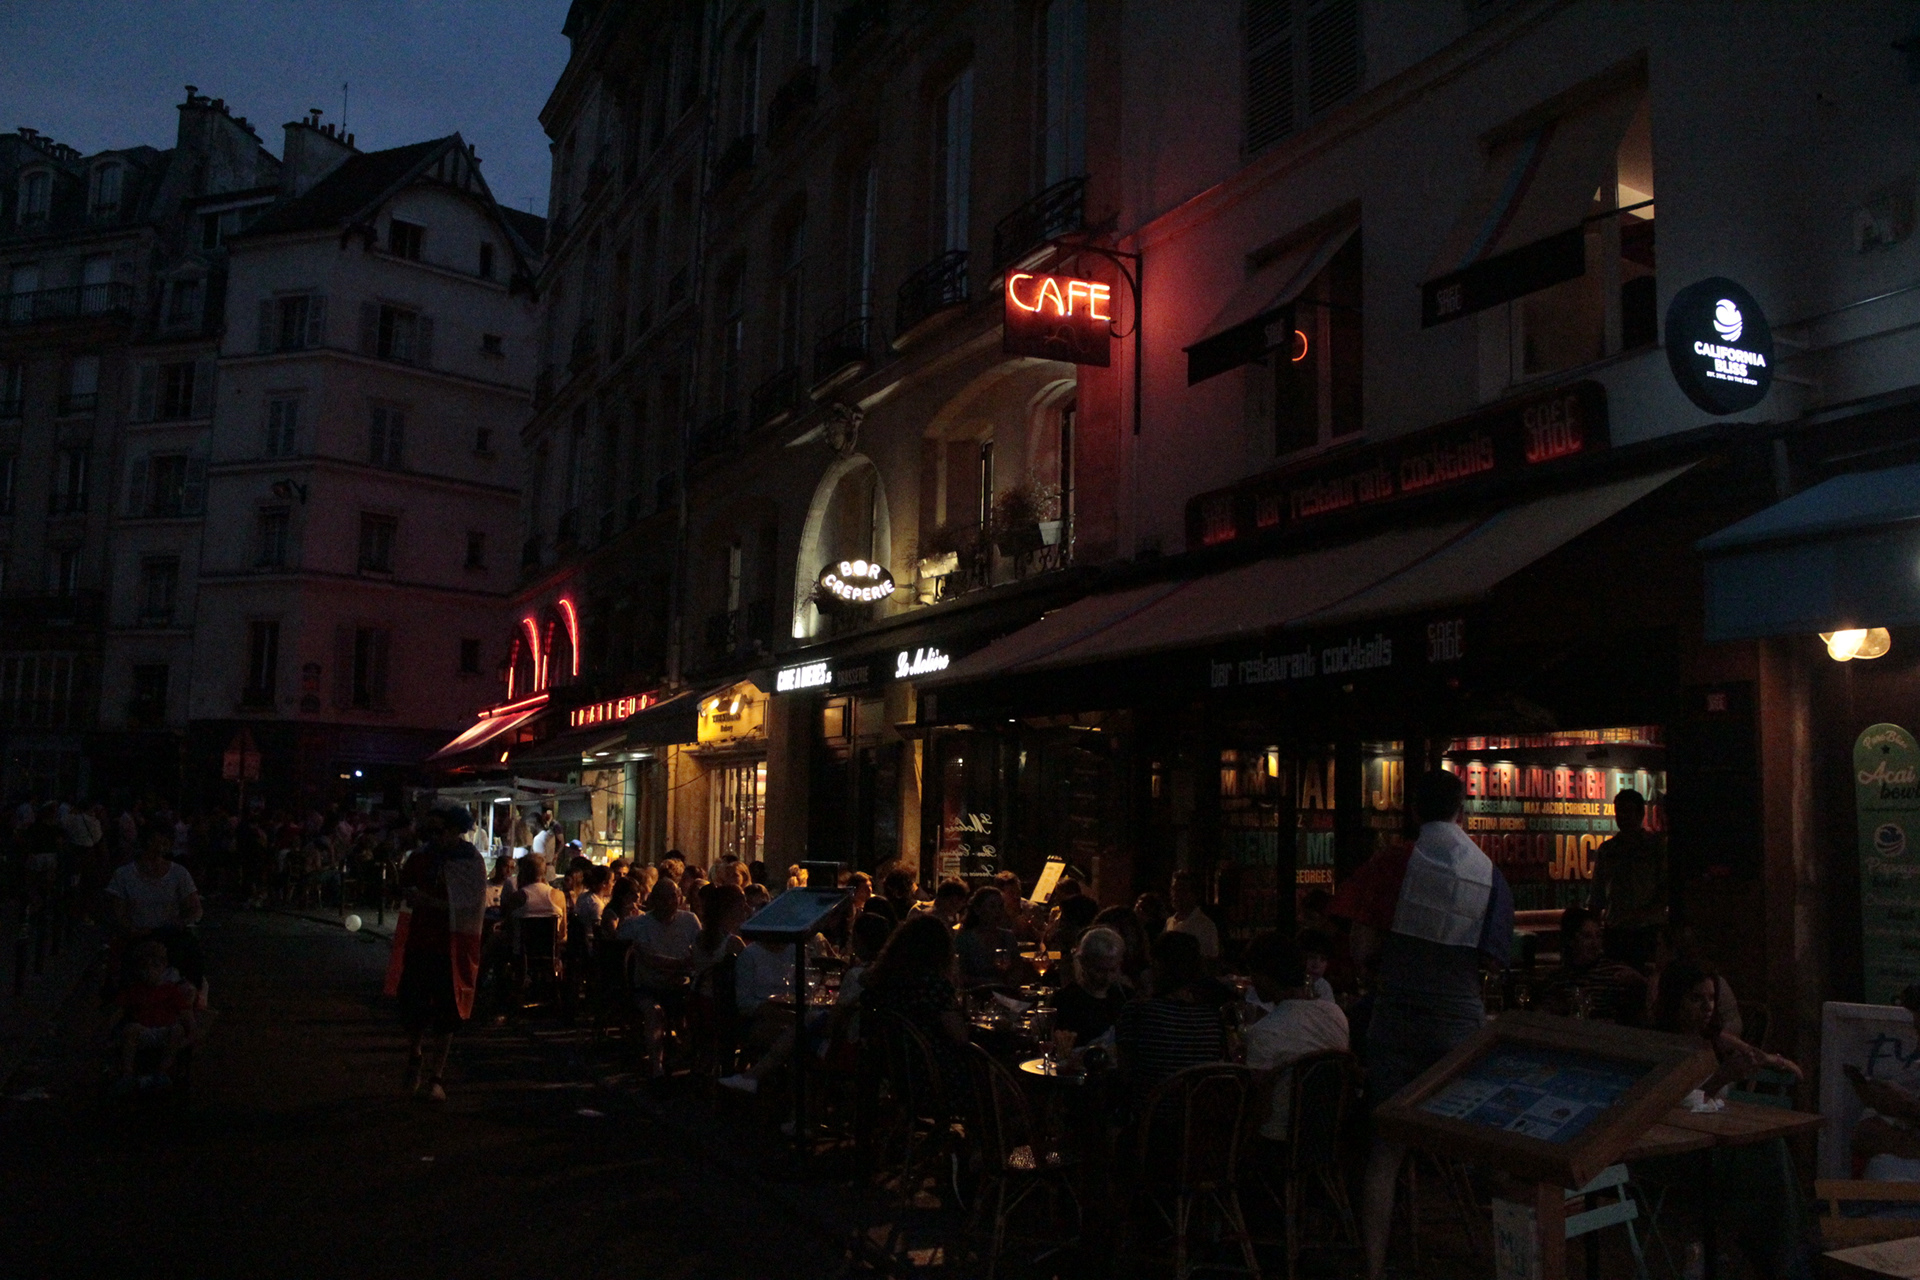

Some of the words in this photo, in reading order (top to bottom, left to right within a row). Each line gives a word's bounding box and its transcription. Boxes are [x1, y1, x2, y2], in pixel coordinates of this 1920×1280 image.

[1009, 273, 1111, 321] CAFE
[1693, 341, 1767, 368] CALIFORNIA
[1714, 358, 1748, 377] BLISS
[825, 574, 895, 601] CREPERIE
[1238, 644, 1316, 685] restaurant
[1321, 632, 1392, 675] cocktails
[1515, 767, 1606, 800] LINDBERGH
[1524, 801, 1540, 814] MAX
[1541, 802, 1563, 814] JACOB
[1564, 802, 1600, 816] CORNEILLE
[1468, 816, 1498, 831] BETTINA
